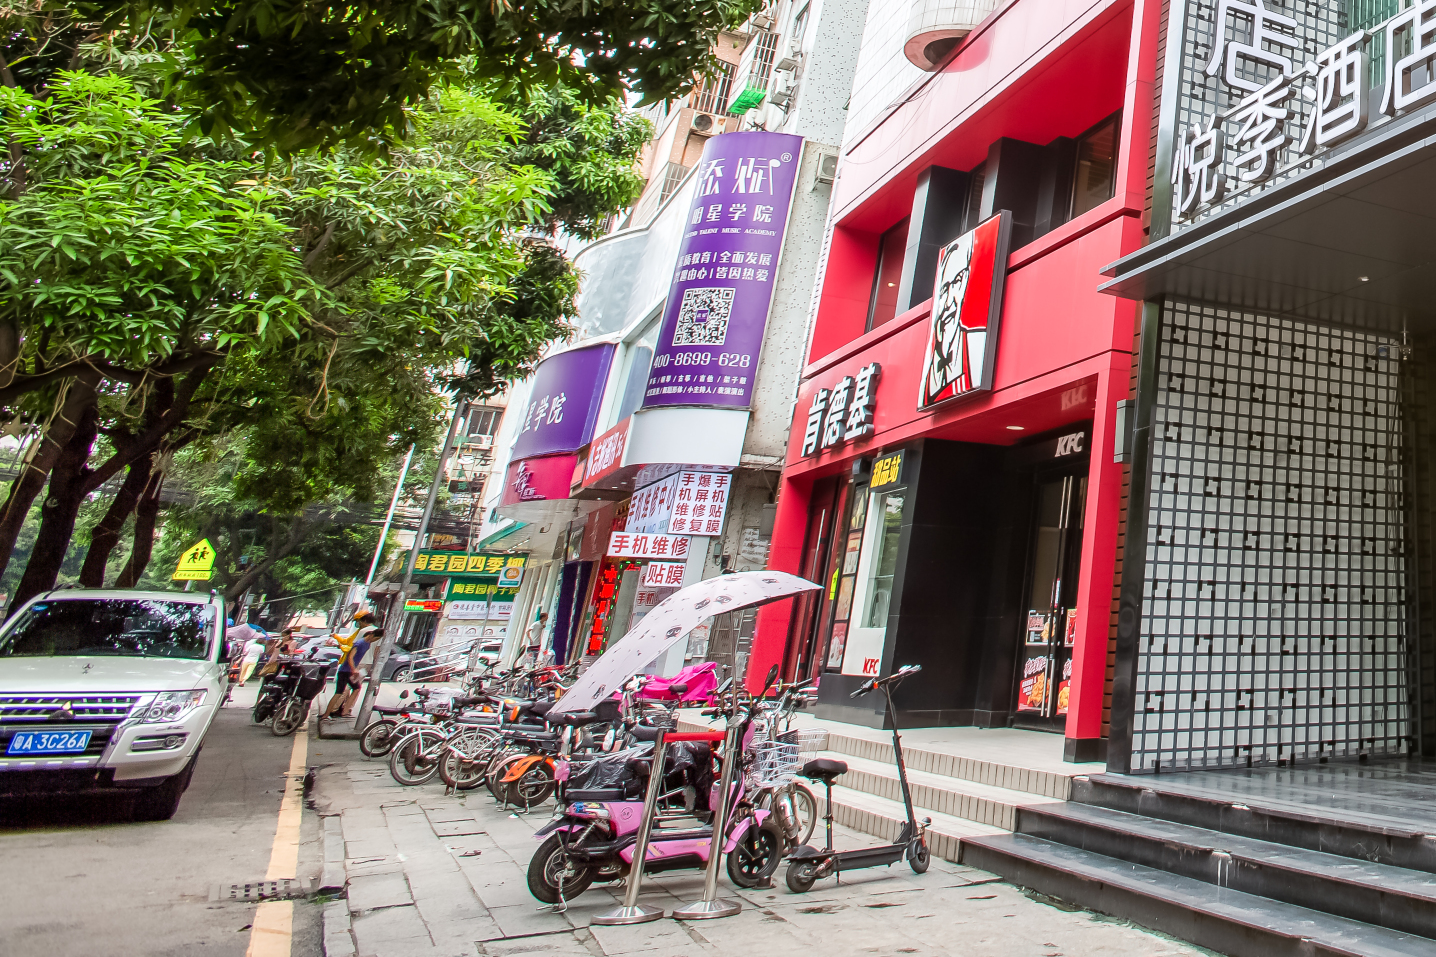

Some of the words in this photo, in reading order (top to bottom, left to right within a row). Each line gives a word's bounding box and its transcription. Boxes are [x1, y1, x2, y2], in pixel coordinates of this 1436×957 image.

[691, 203, 774, 224] 明星学院
[744, 228, 777, 237] ACADEMY
[653, 352, 751, 368] 400-8699-628
[801, 362, 879, 457] 肯德基
[1054, 431, 1085, 457] KFC
[870, 454, 901, 488] 甜品站
[672, 473, 695, 532] 手机维修
[689, 474, 712, 532] 爆屏修复
[706, 475, 729, 533] 手机贴膜
[611, 535, 689, 556] 手机维修
[647, 564, 684, 585] 贴膜
[863, 657, 880, 674] KFC
